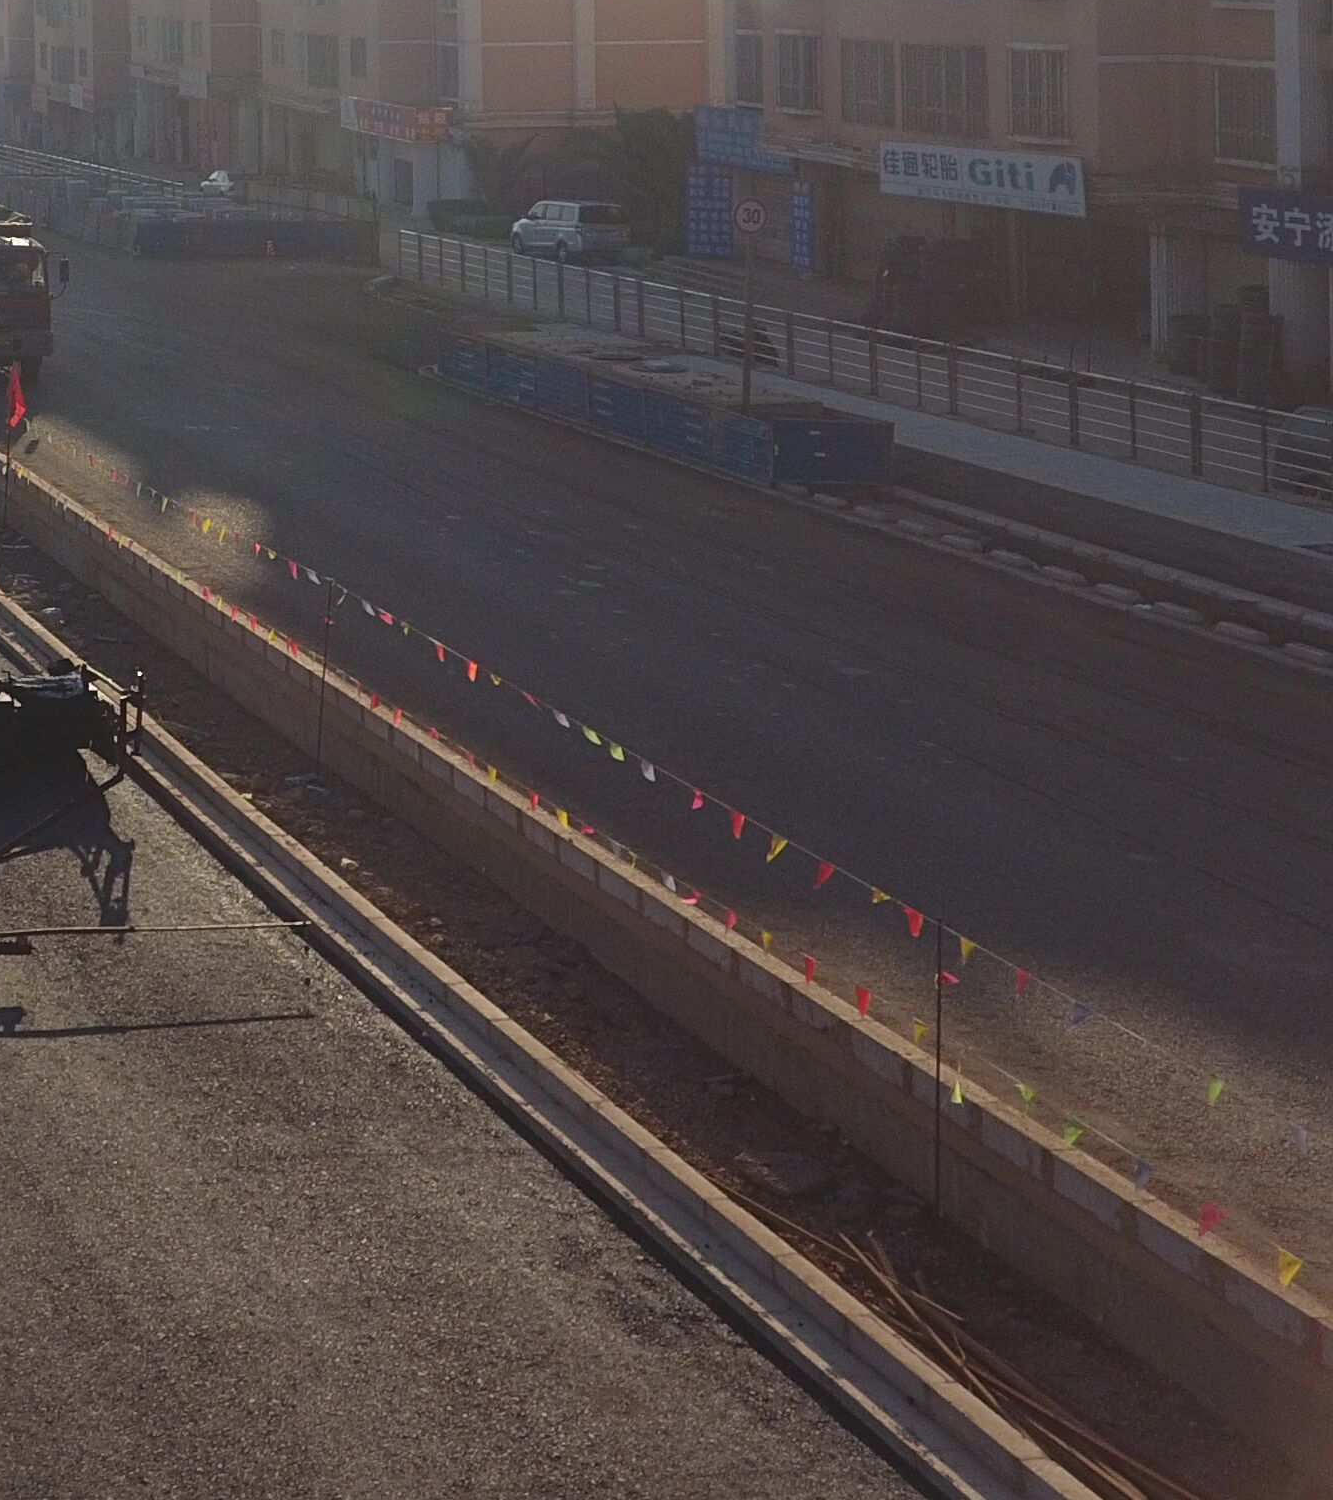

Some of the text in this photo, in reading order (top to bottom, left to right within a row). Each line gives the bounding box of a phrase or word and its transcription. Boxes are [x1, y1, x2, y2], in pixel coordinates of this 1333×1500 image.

[883, 149, 1035, 191] 佳通轮胎 Giti
[741, 207, 761, 224] 30
